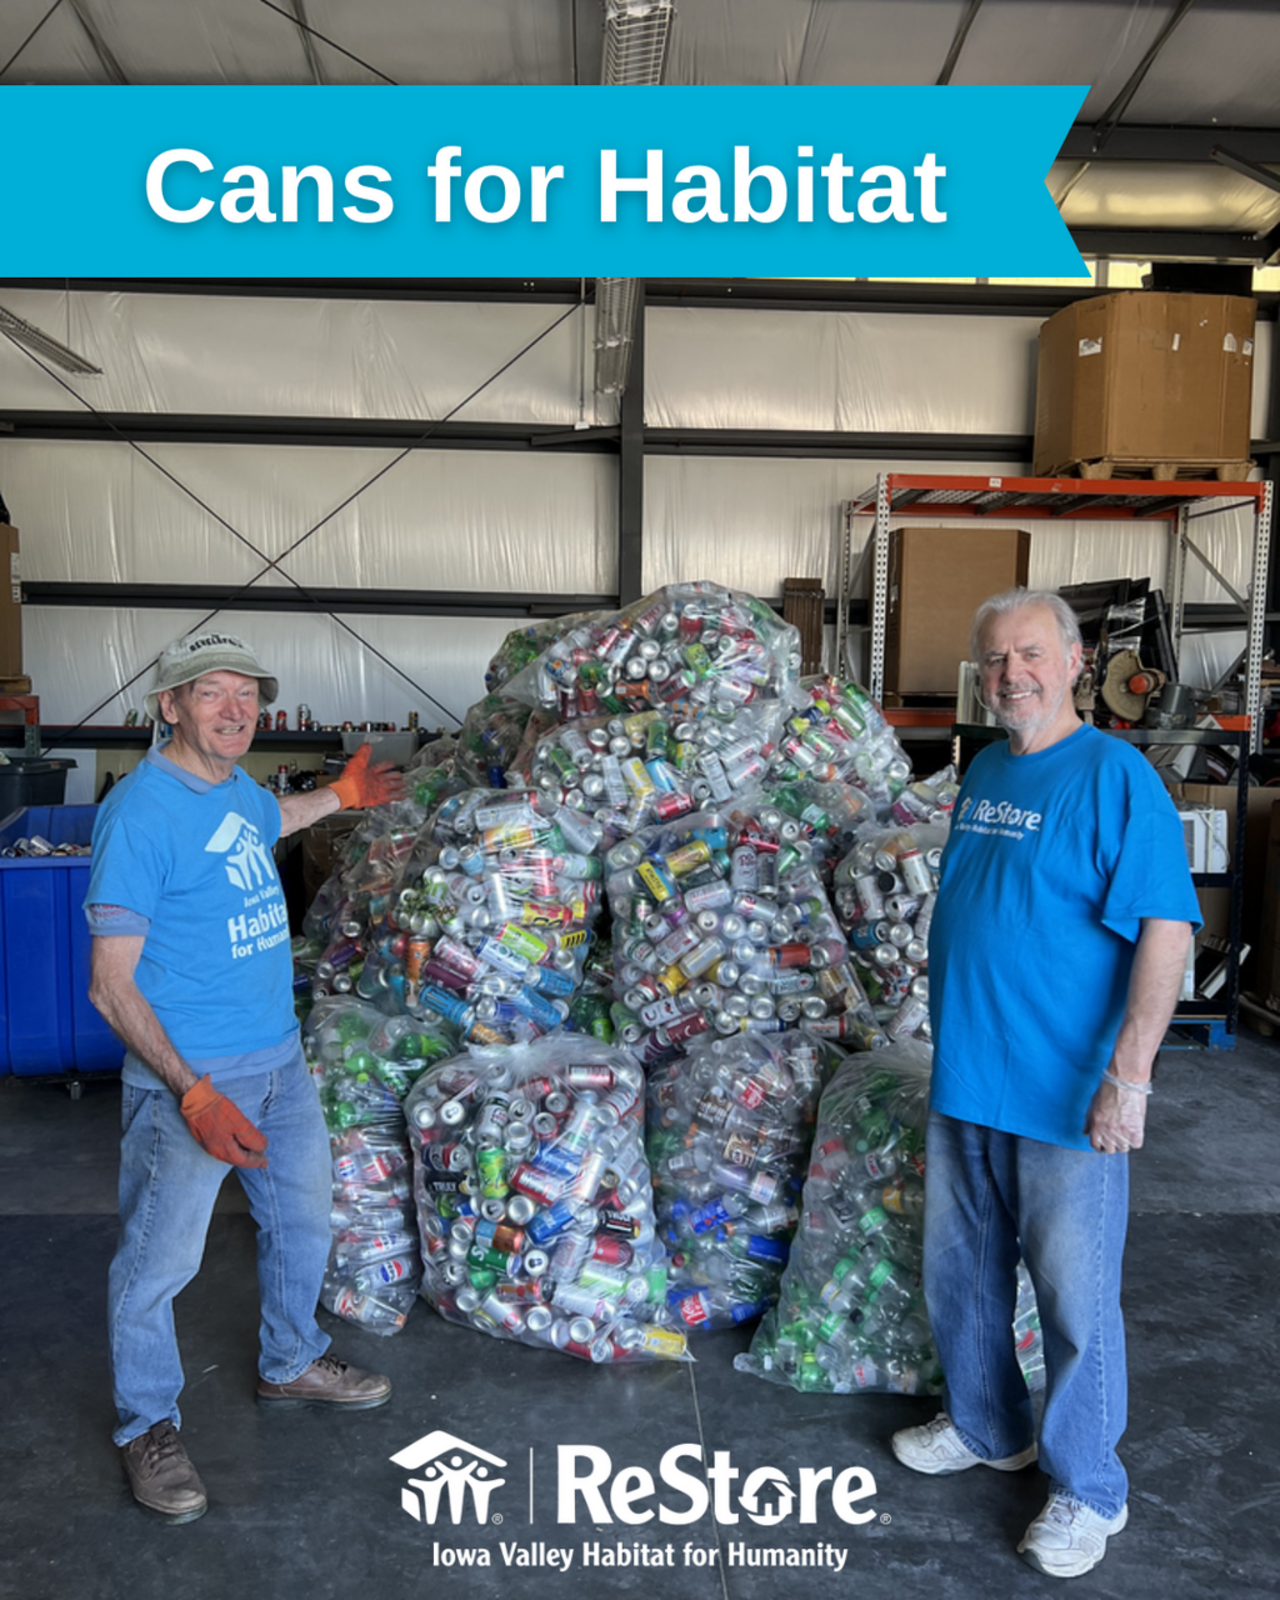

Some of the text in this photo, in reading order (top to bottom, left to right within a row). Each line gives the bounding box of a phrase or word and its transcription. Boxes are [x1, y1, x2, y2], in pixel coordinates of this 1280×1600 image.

[972, 798, 1042, 831] ReStore
[259, 885, 280, 900] Valley
[227, 902, 289, 944] Habita
[231, 943, 254, 960] for
